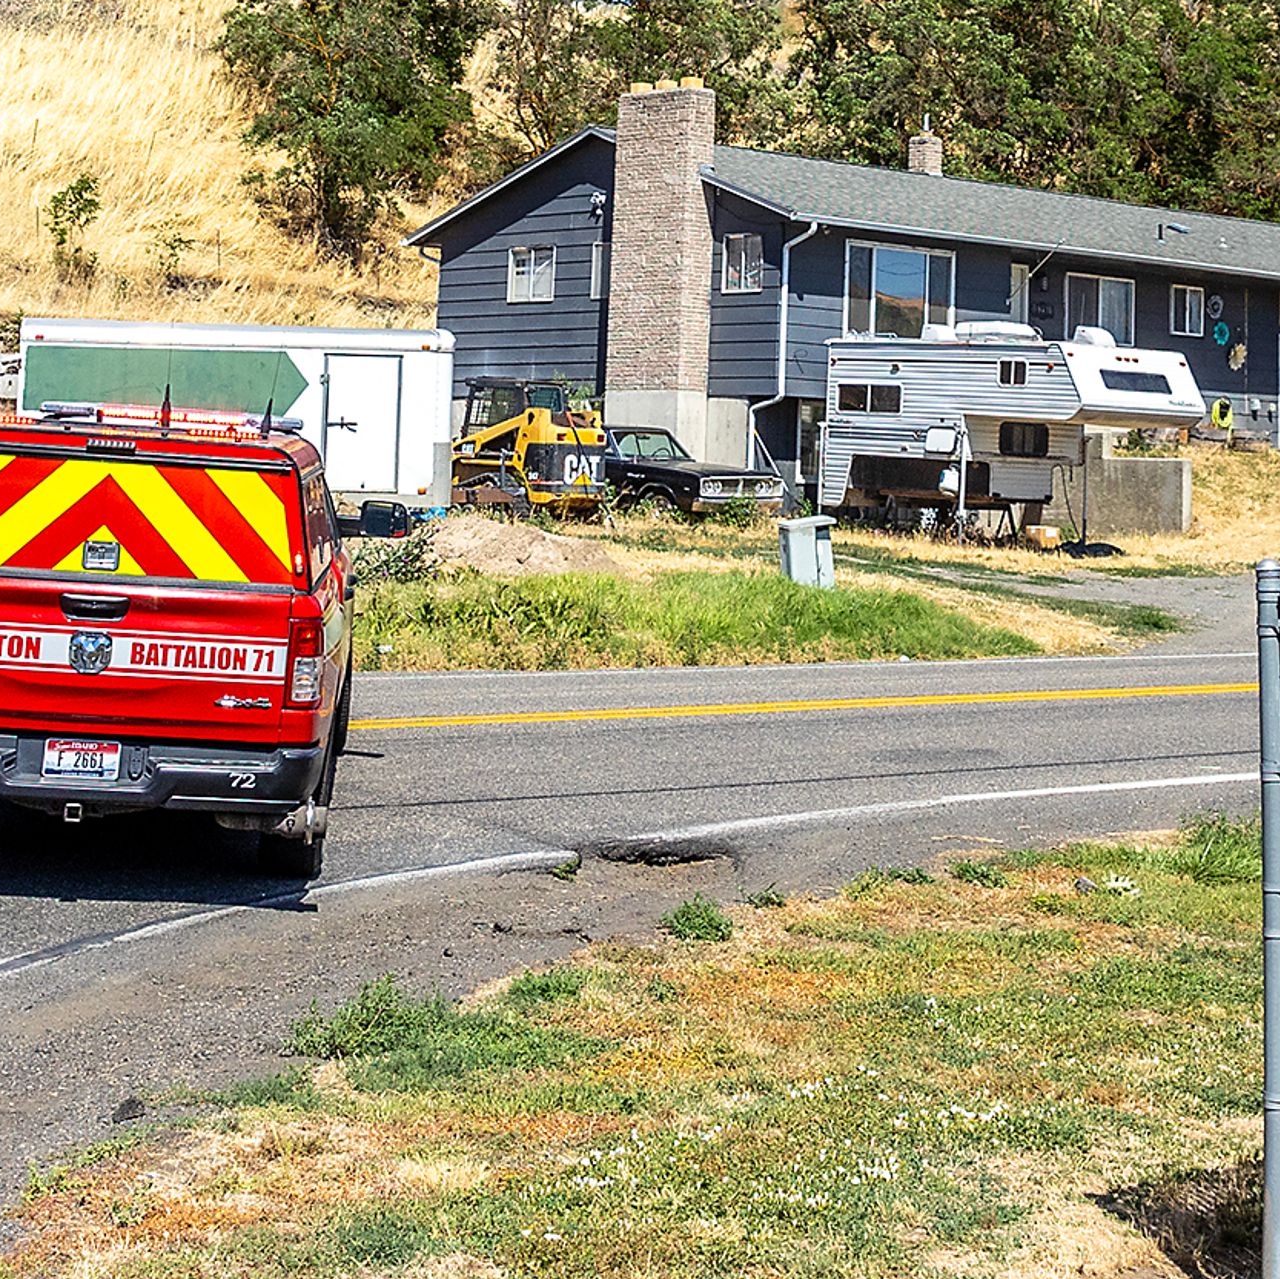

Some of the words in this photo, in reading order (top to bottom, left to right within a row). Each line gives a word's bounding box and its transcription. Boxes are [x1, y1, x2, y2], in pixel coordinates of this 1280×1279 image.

[563, 454, 602, 485] CAT
[130, 643, 249, 671] BATTALION
[252, 648, 276, 673] 71
[57, 750, 66, 767] F
[73, 751, 105, 769] 2661
[228, 771, 257, 789] 72
